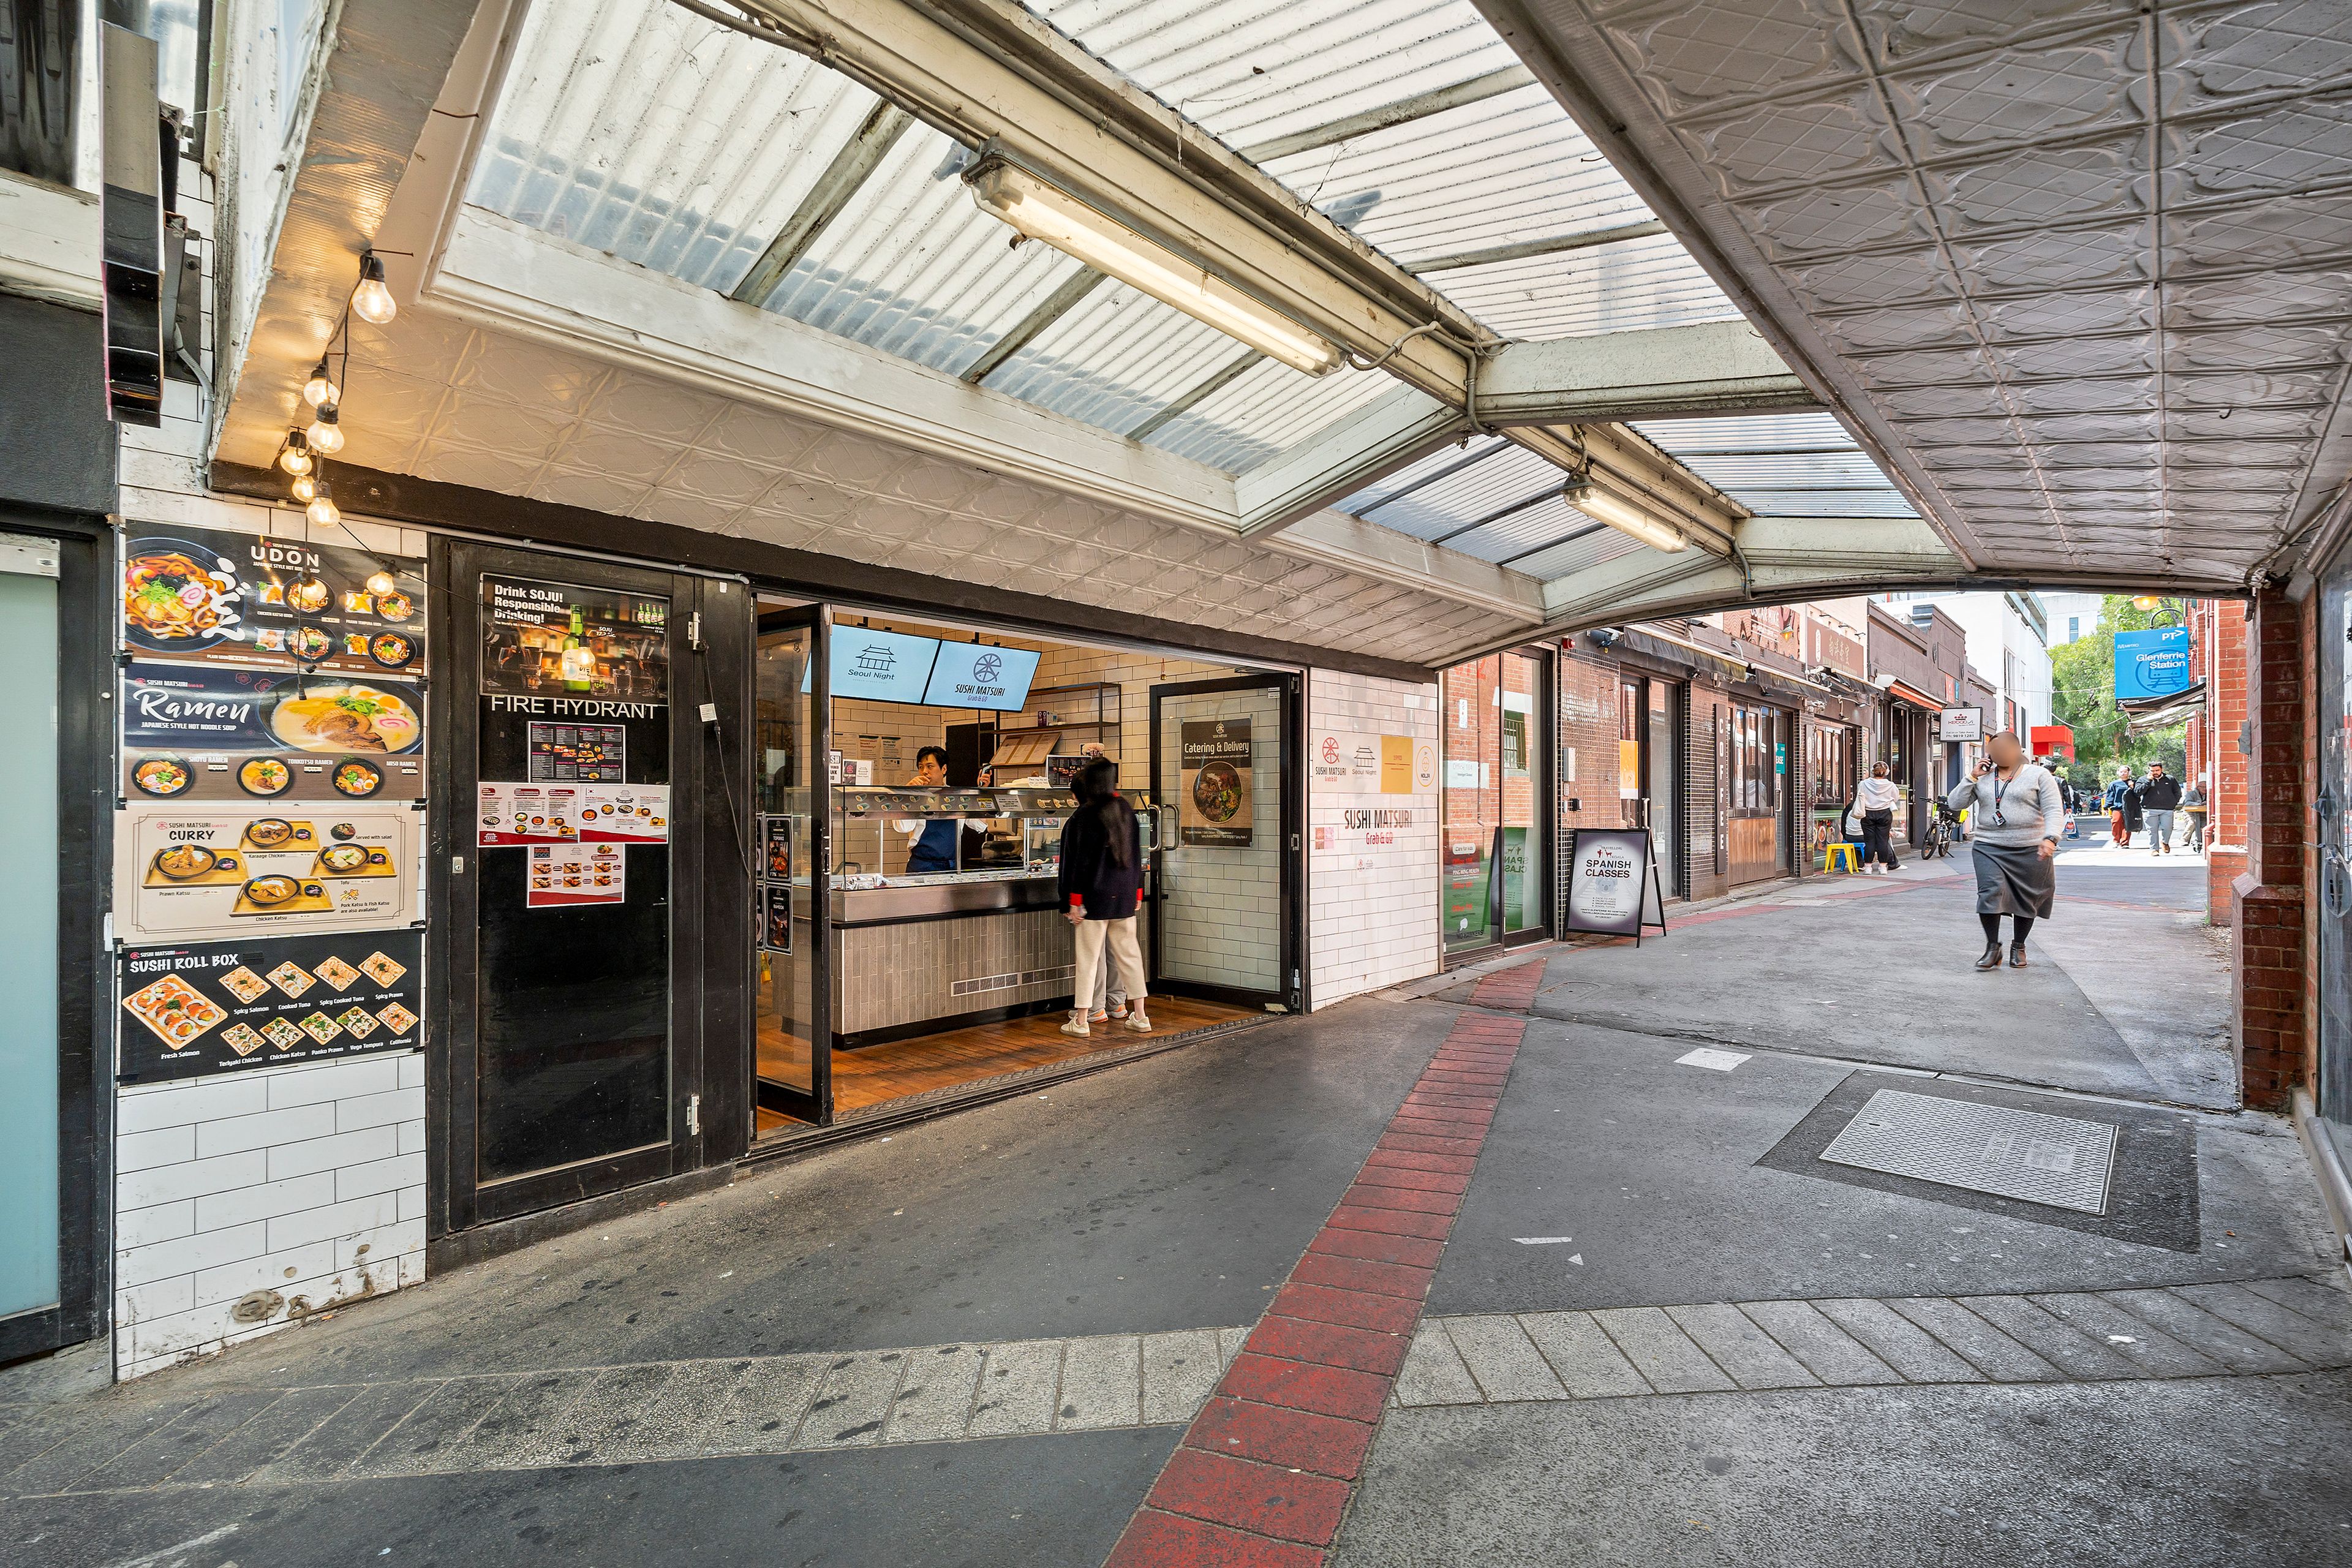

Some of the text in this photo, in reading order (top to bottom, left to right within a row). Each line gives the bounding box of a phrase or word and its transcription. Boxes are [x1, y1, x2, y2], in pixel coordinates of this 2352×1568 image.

[251, 545, 319, 567] UDON
[494, 584, 563, 603] Drink SOJU!
[494, 596, 560, 613] Responsible
[494, 608, 545, 625] Drinking!
[2136, 652, 2185, 662] Glenferrie
[848, 669, 895, 680] Seoul Night
[955, 684, 1006, 696] SUSHI MATSURI
[133, 688, 251, 723] Ramen
[491, 695, 658, 720] FIRE HYDRANT
[1184, 741, 1249, 755] Catering & Delivery
[1329, 767, 1347, 775] MATSURI
[1344, 810, 1412, 829] SUSHI MATSURI
[169, 830, 215, 840] CURRY
[1366, 832, 1379, 845] Grab
[1380, 832, 1385, 844] &
[1586, 859, 1631, 869] SPANISH
[1585, 869, 1630, 878] CLASSES
[1463, 930, 1483, 938] HAWKERS
[130, 954, 239, 973] SUSHI ROLL BOX
[1992, 1138, 2008, 1148] NOT
[1983, 1147, 2004, 1164] COVER
